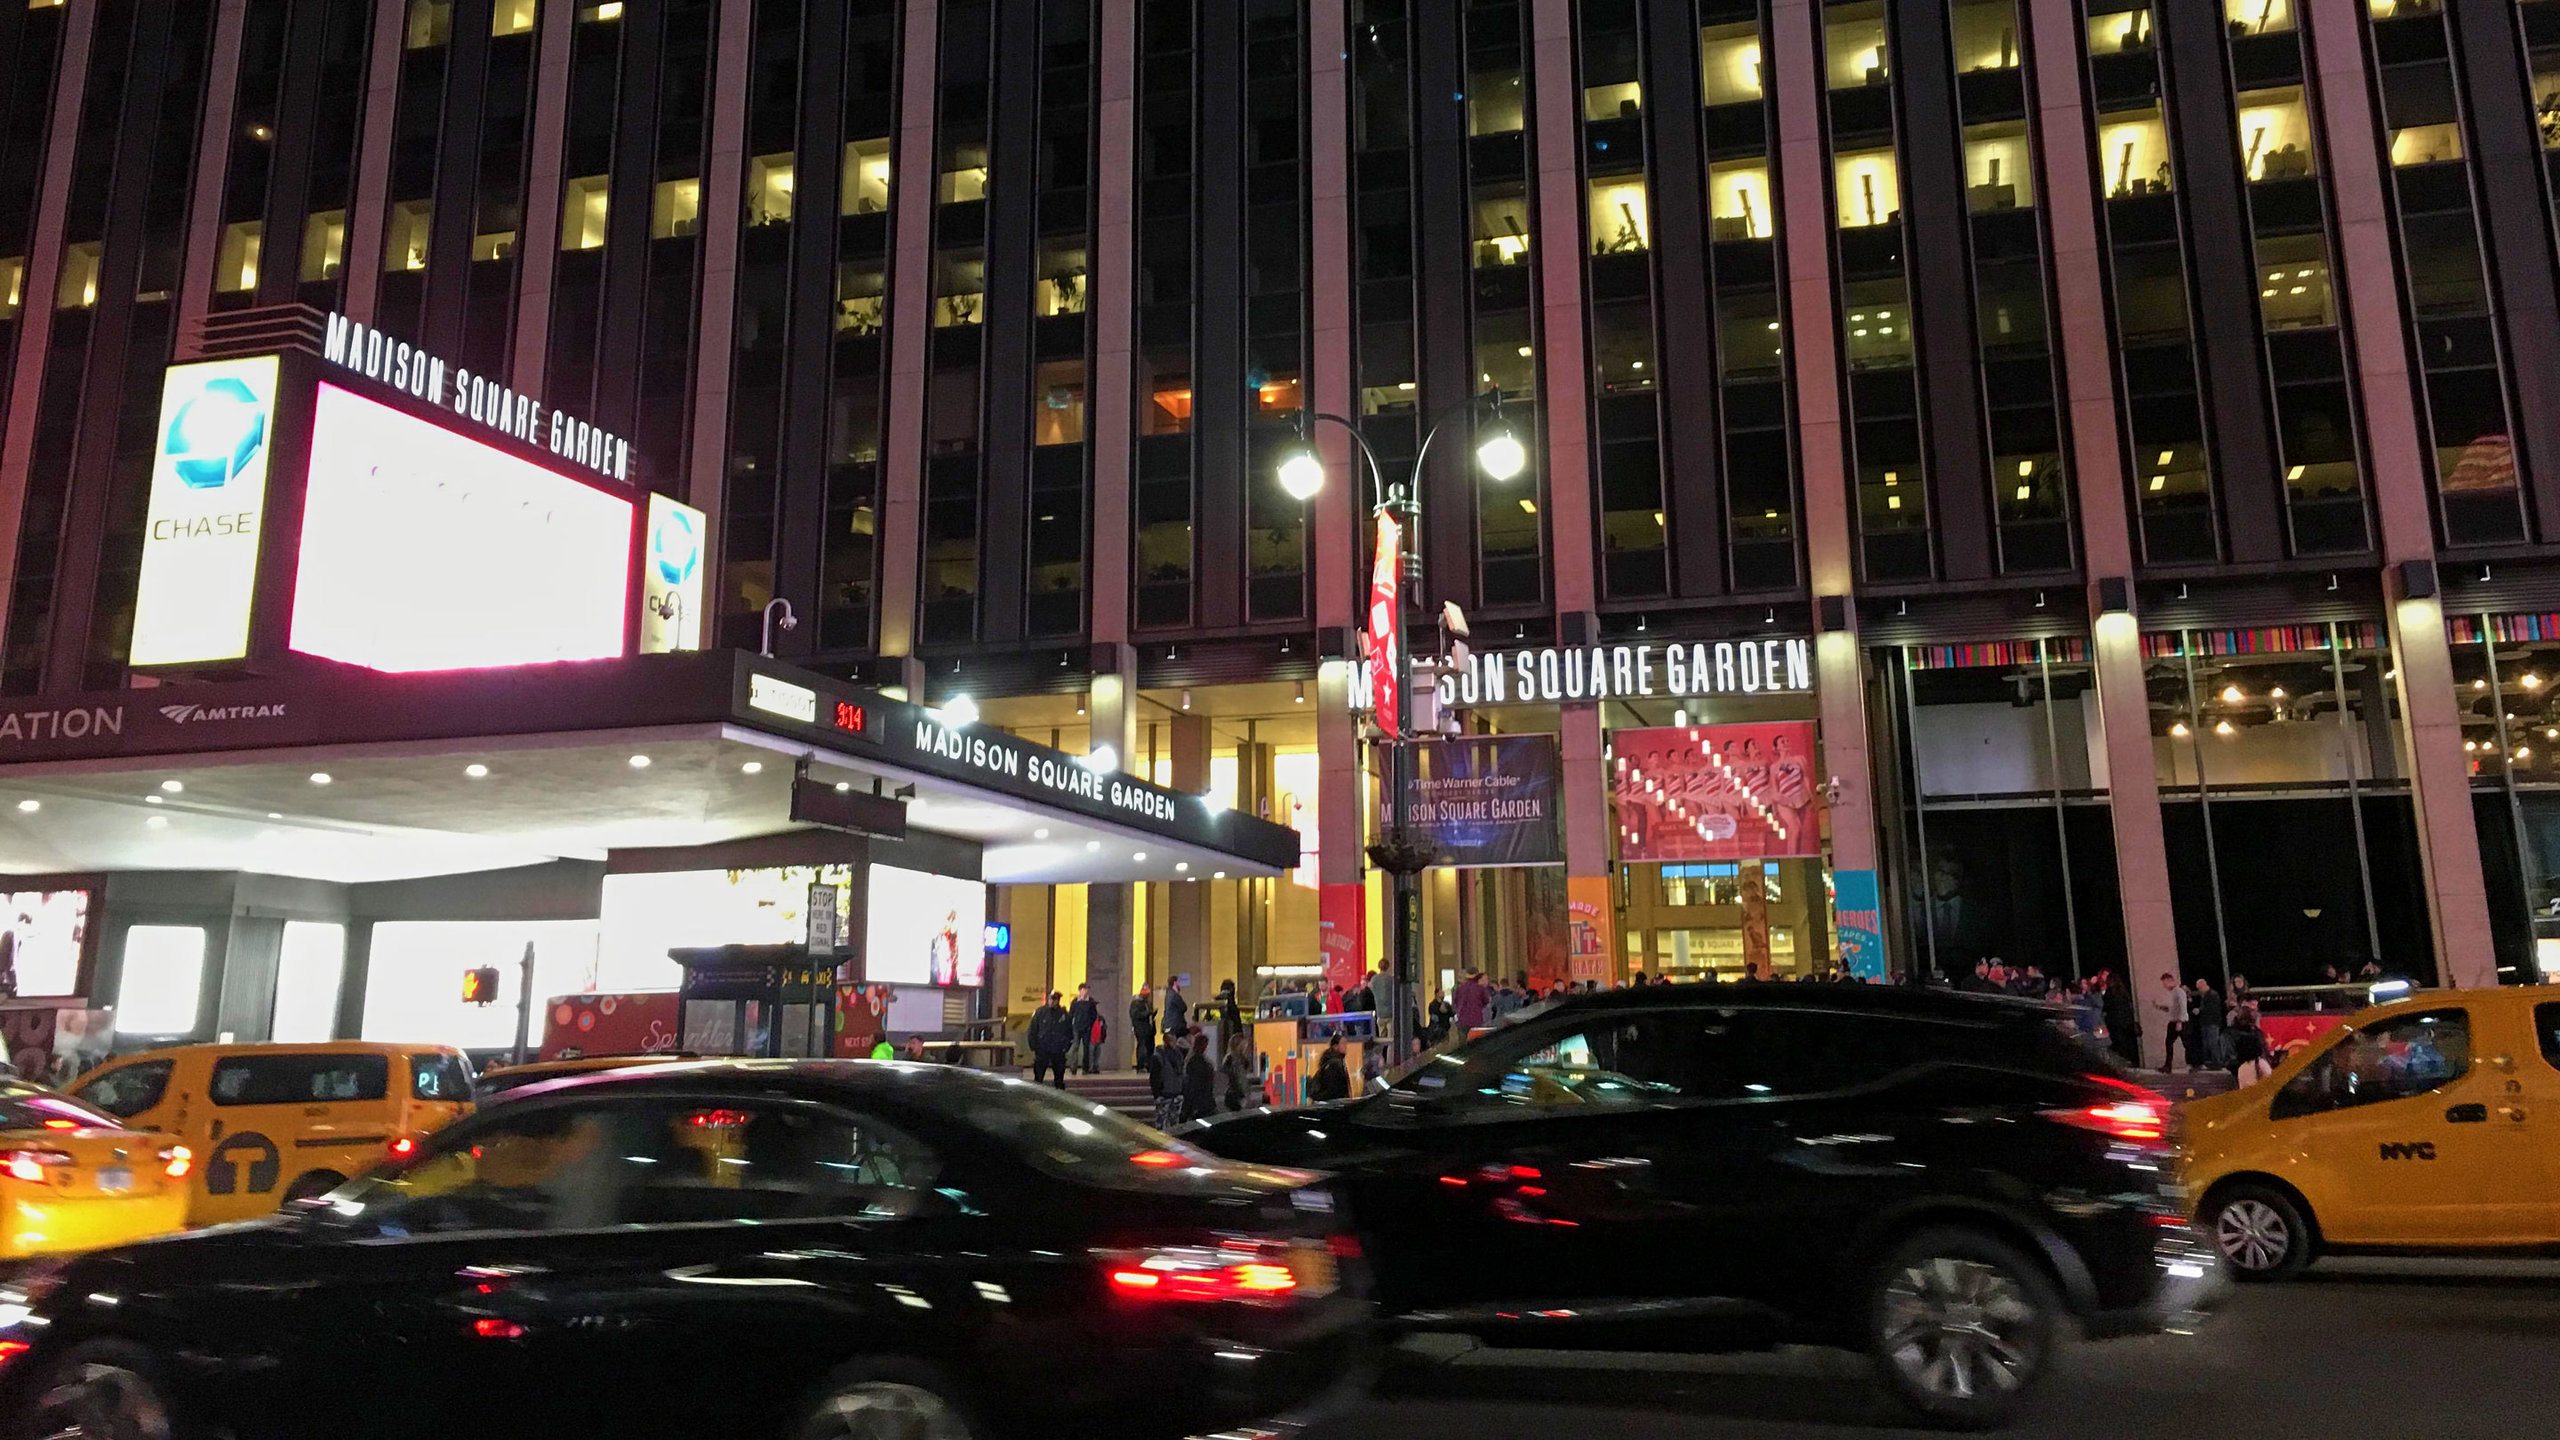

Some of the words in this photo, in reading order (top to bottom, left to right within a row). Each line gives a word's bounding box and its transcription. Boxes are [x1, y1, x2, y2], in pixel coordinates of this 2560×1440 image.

[324, 311, 445, 405] MADISON
[454, 368, 541, 445] SQUARE
[549, 409, 629, 481] GARDEN
[153, 512, 254, 540] CHASE
[1348, 652, 1505, 709] MSON
[1517, 645, 1653, 700] SQUARE
[1667, 639, 1810, 694] GARDEN
[192, 704, 286, 722] AMTRAK
[915, 721, 1018, 776] MADISON
[1027, 755, 1104, 801] SQUARE
[1110, 781, 1175, 822] GARDEN
[1414, 779, 1442, 790] Time
[1442, 777, 1483, 789] Warner
[1381, 803, 1437, 823] MISON
[1440, 800, 1488, 824] SQUARE
[812, 891, 833, 908] STOP
[2379, 1142, 2437, 1161] NYC
